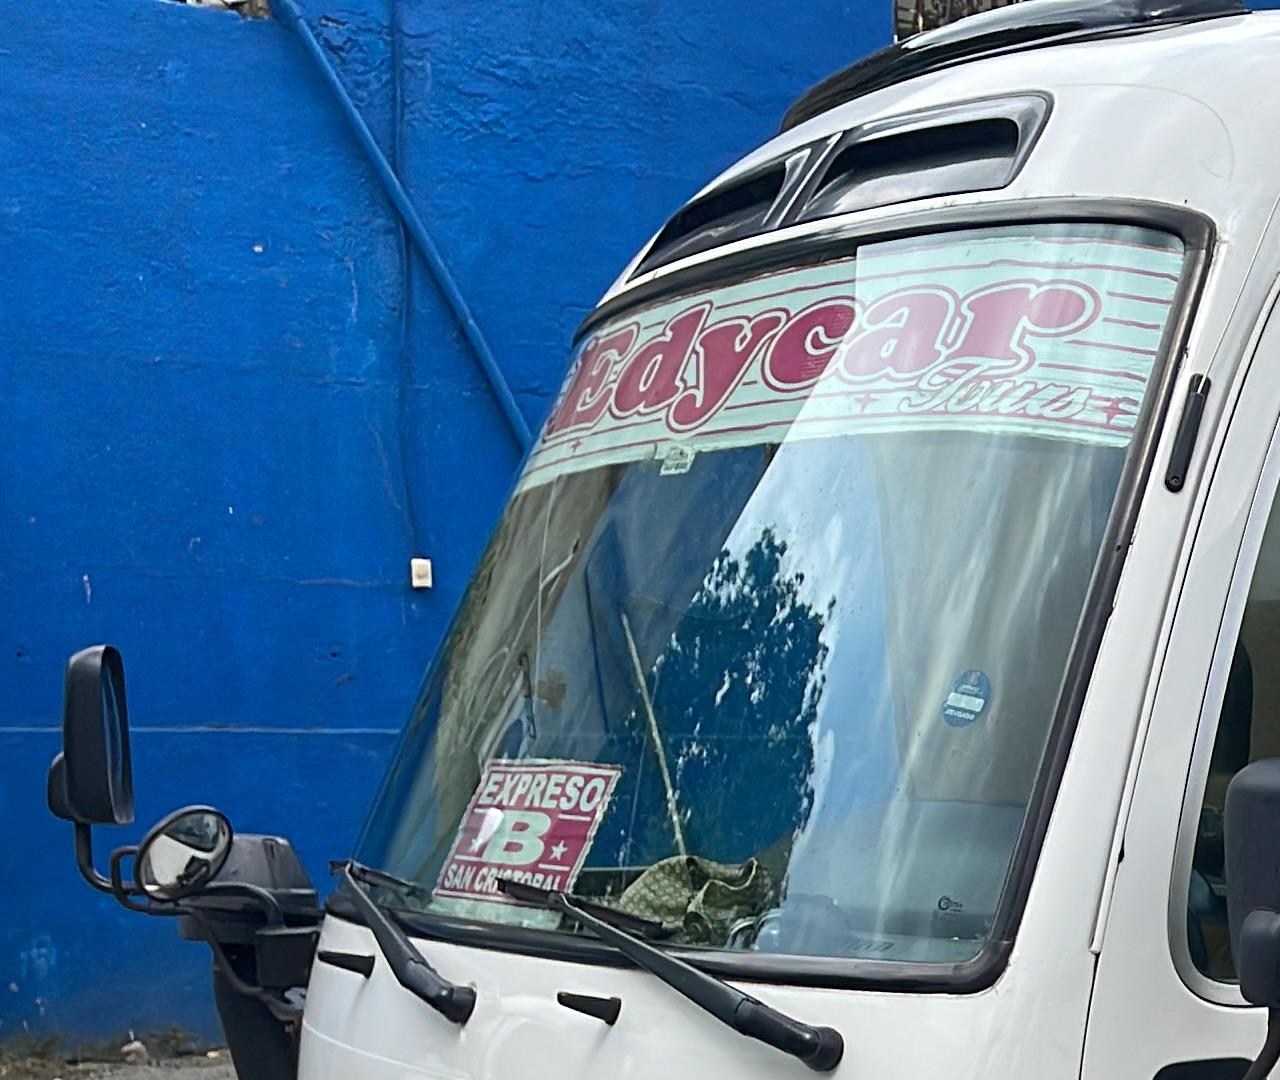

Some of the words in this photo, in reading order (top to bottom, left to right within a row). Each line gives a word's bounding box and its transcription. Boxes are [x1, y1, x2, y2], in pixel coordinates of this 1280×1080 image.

[545, 279, 1100, 433] Edycar
[898, 355, 1093, 419] Tours
[479, 772, 605, 812] EXPRESO
[480, 810, 551, 865] B
[444, 863, 477, 889] SAN
